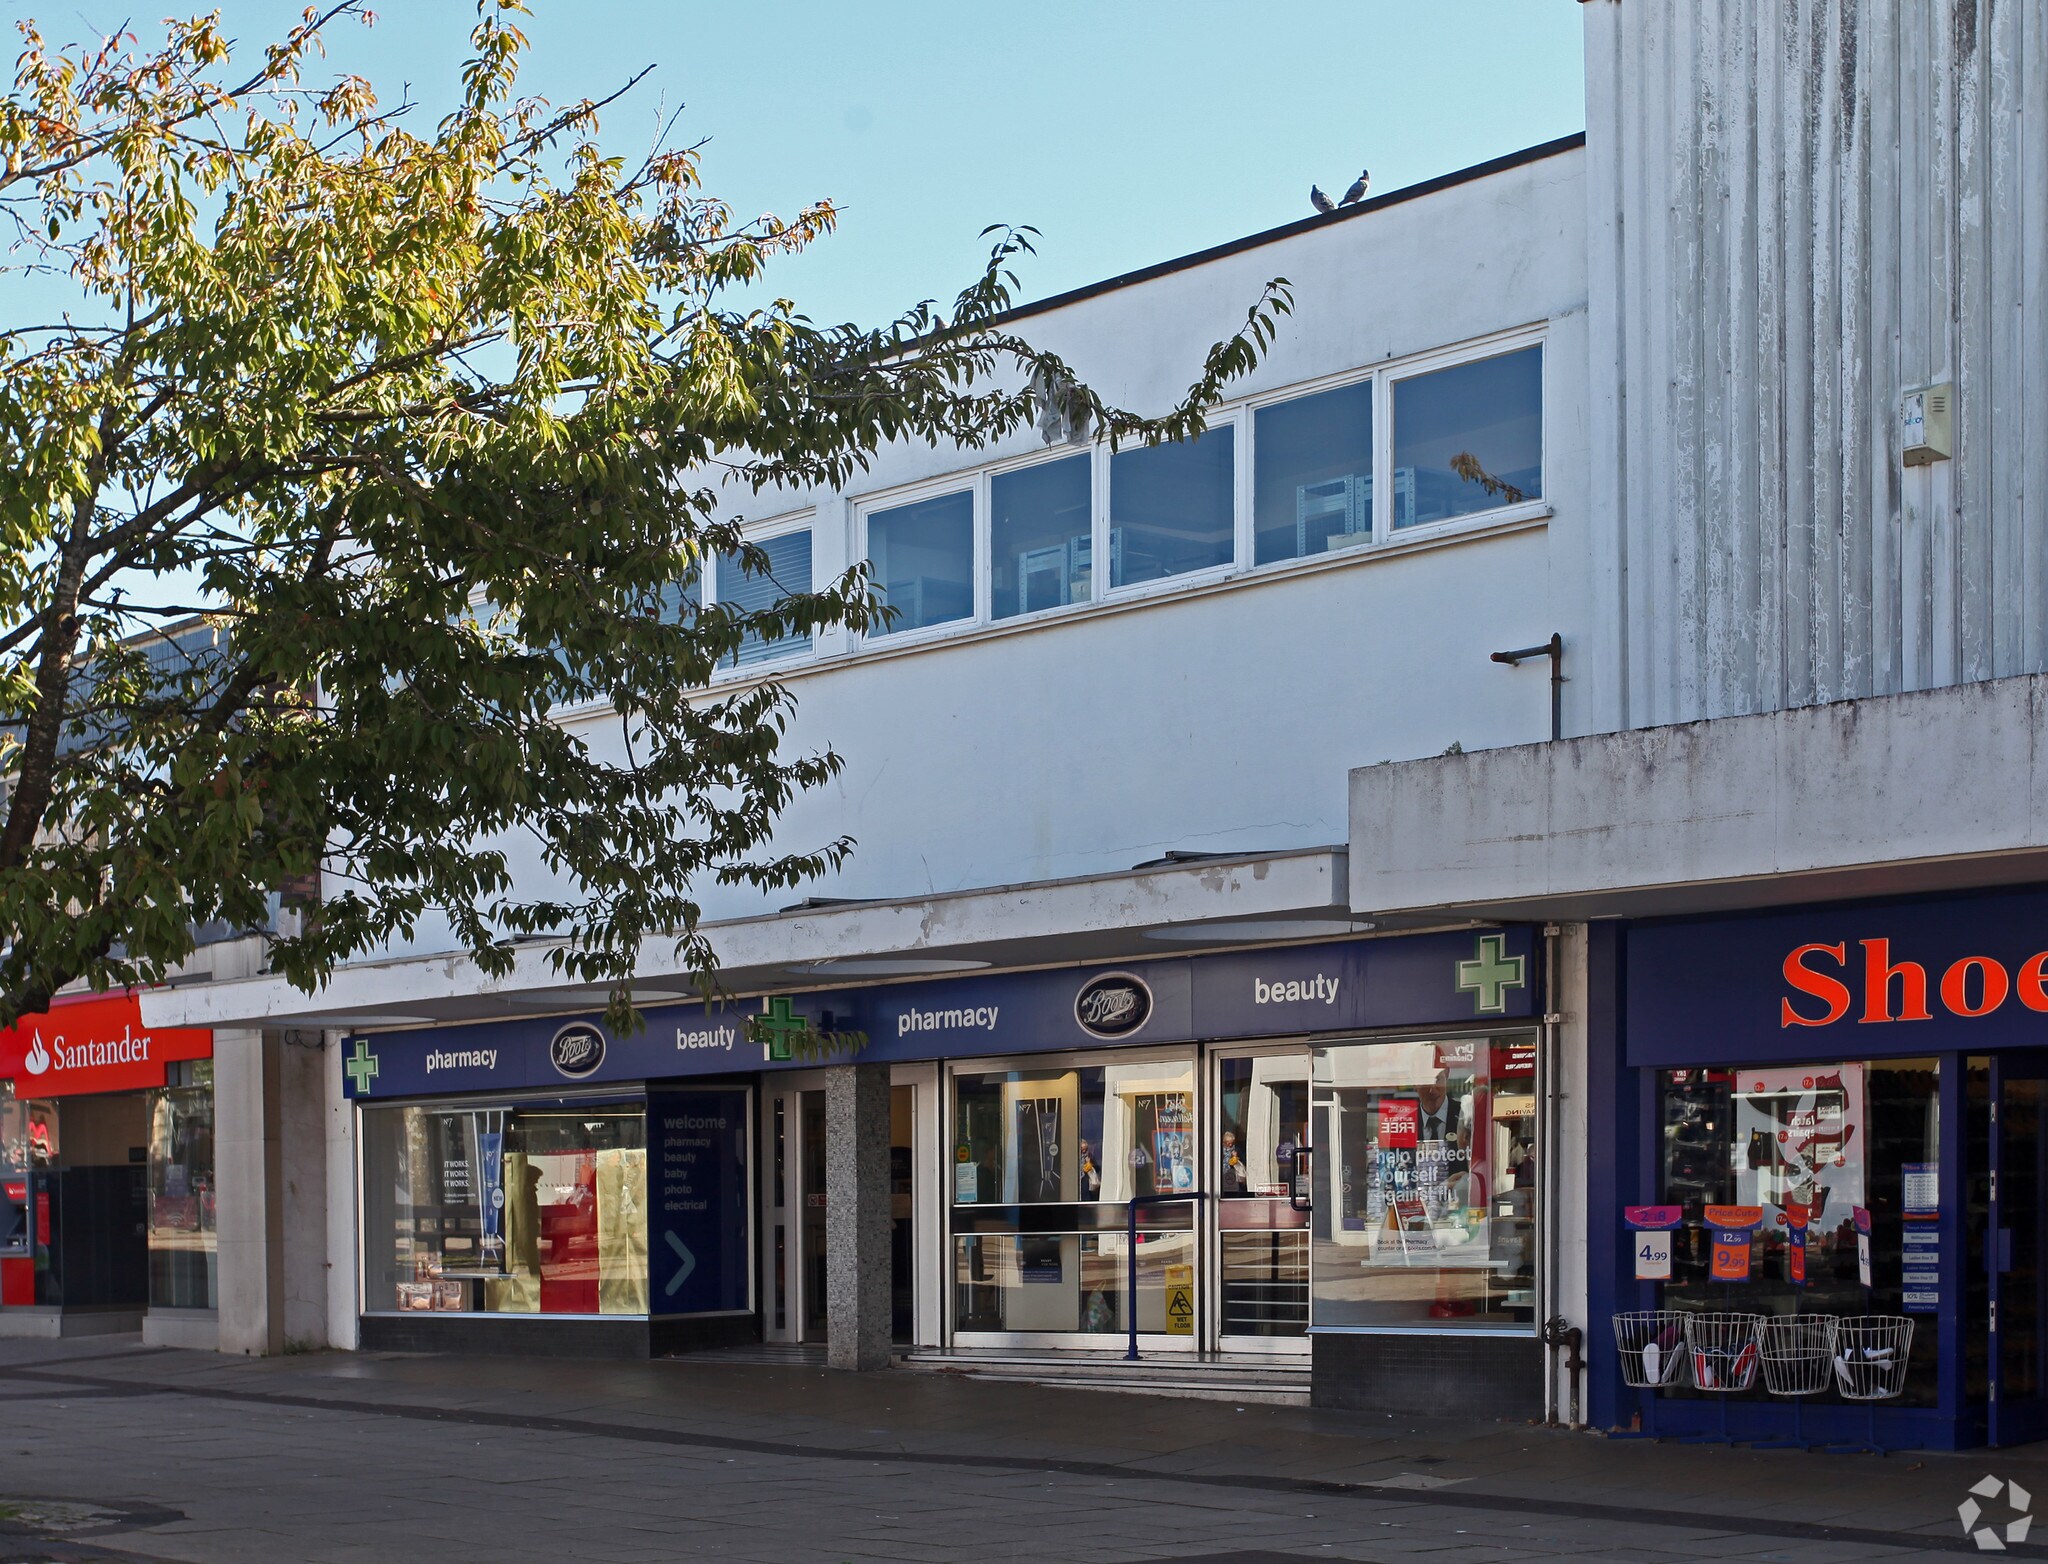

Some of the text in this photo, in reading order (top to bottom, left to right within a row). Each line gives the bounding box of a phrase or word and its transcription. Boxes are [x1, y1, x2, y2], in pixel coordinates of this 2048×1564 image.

[1255, 973, 1339, 1005] beauty
[1081, 987, 1138, 1024] Boots
[898, 1006, 998, 1037] pharmacy
[676, 1025, 735, 1051] beauty
[54, 1024, 151, 1071] Santander
[557, 1035, 593, 1066] Boots
[426, 1049, 498, 1074] pharmacy
[664, 1114, 727, 1129] welcome
[664, 1137, 711, 1149] pharmacy
[444, 1160, 470, 1168] IT WORKS.
[664, 1152, 696, 1164] beauty
[1376, 1146, 1472, 1166] help protect
[444, 1170, 470, 1178] IT WORKS.
[664, 1168, 687, 1180] baby
[1375, 1166, 1439, 1186] yourself
[444, 1180, 470, 1188] IT WORKS.
[664, 1185, 692, 1196] photo
[664, 1199, 707, 1211] electrical
[1709, 1208, 1734, 1217] Price
[1723, 1233, 1742, 1243] 12.99
[1639, 1244, 1668, 1261] 4.99
[1717, 1250, 1745, 1268] 9.99
